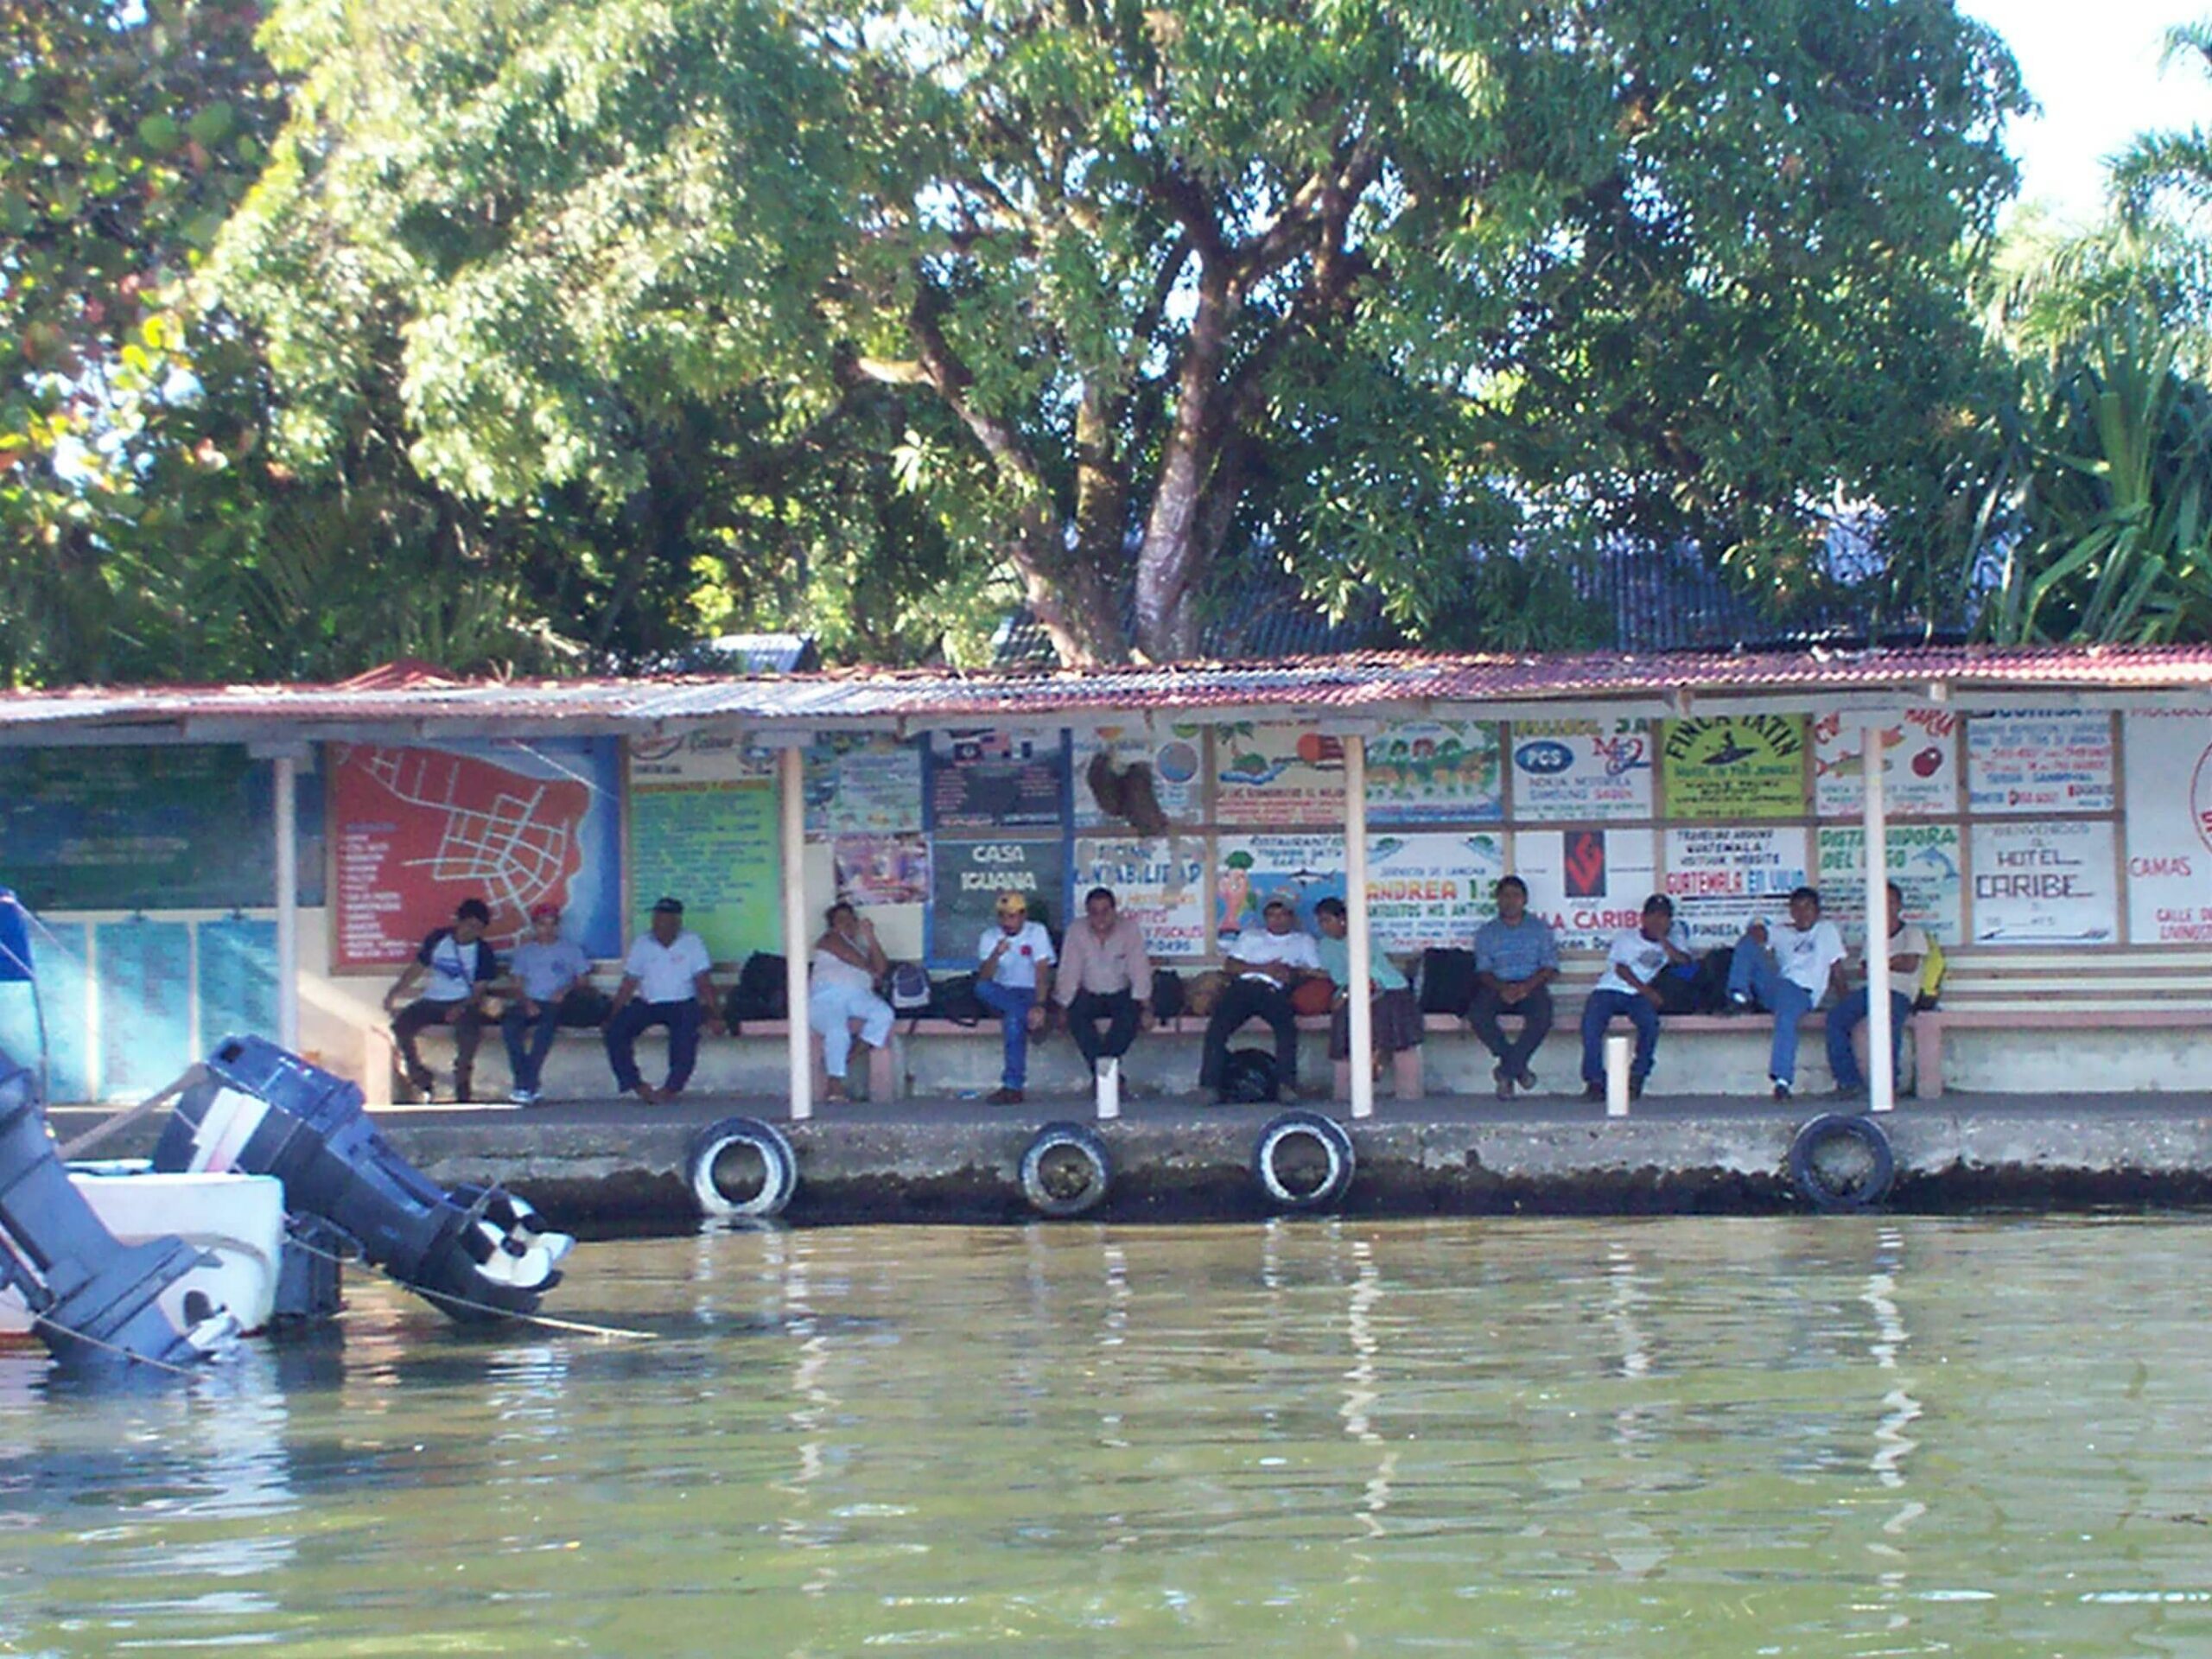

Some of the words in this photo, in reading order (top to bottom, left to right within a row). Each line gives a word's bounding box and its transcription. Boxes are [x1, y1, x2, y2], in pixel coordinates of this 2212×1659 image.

[1527, 750, 1561, 766] PCS
[973, 846, 1025, 862] CASA
[1997, 849, 2082, 866] HOTEL
[2128, 856, 2191, 877] CAMAS
[961, 872, 1037, 891] IGUANA
[1366, 880, 1457, 900] ANDREA
[1666, 871, 1742, 894] GUATEMALA
[1975, 874, 2095, 899] CARIBE
[1574, 910, 1645, 930] CARIB
